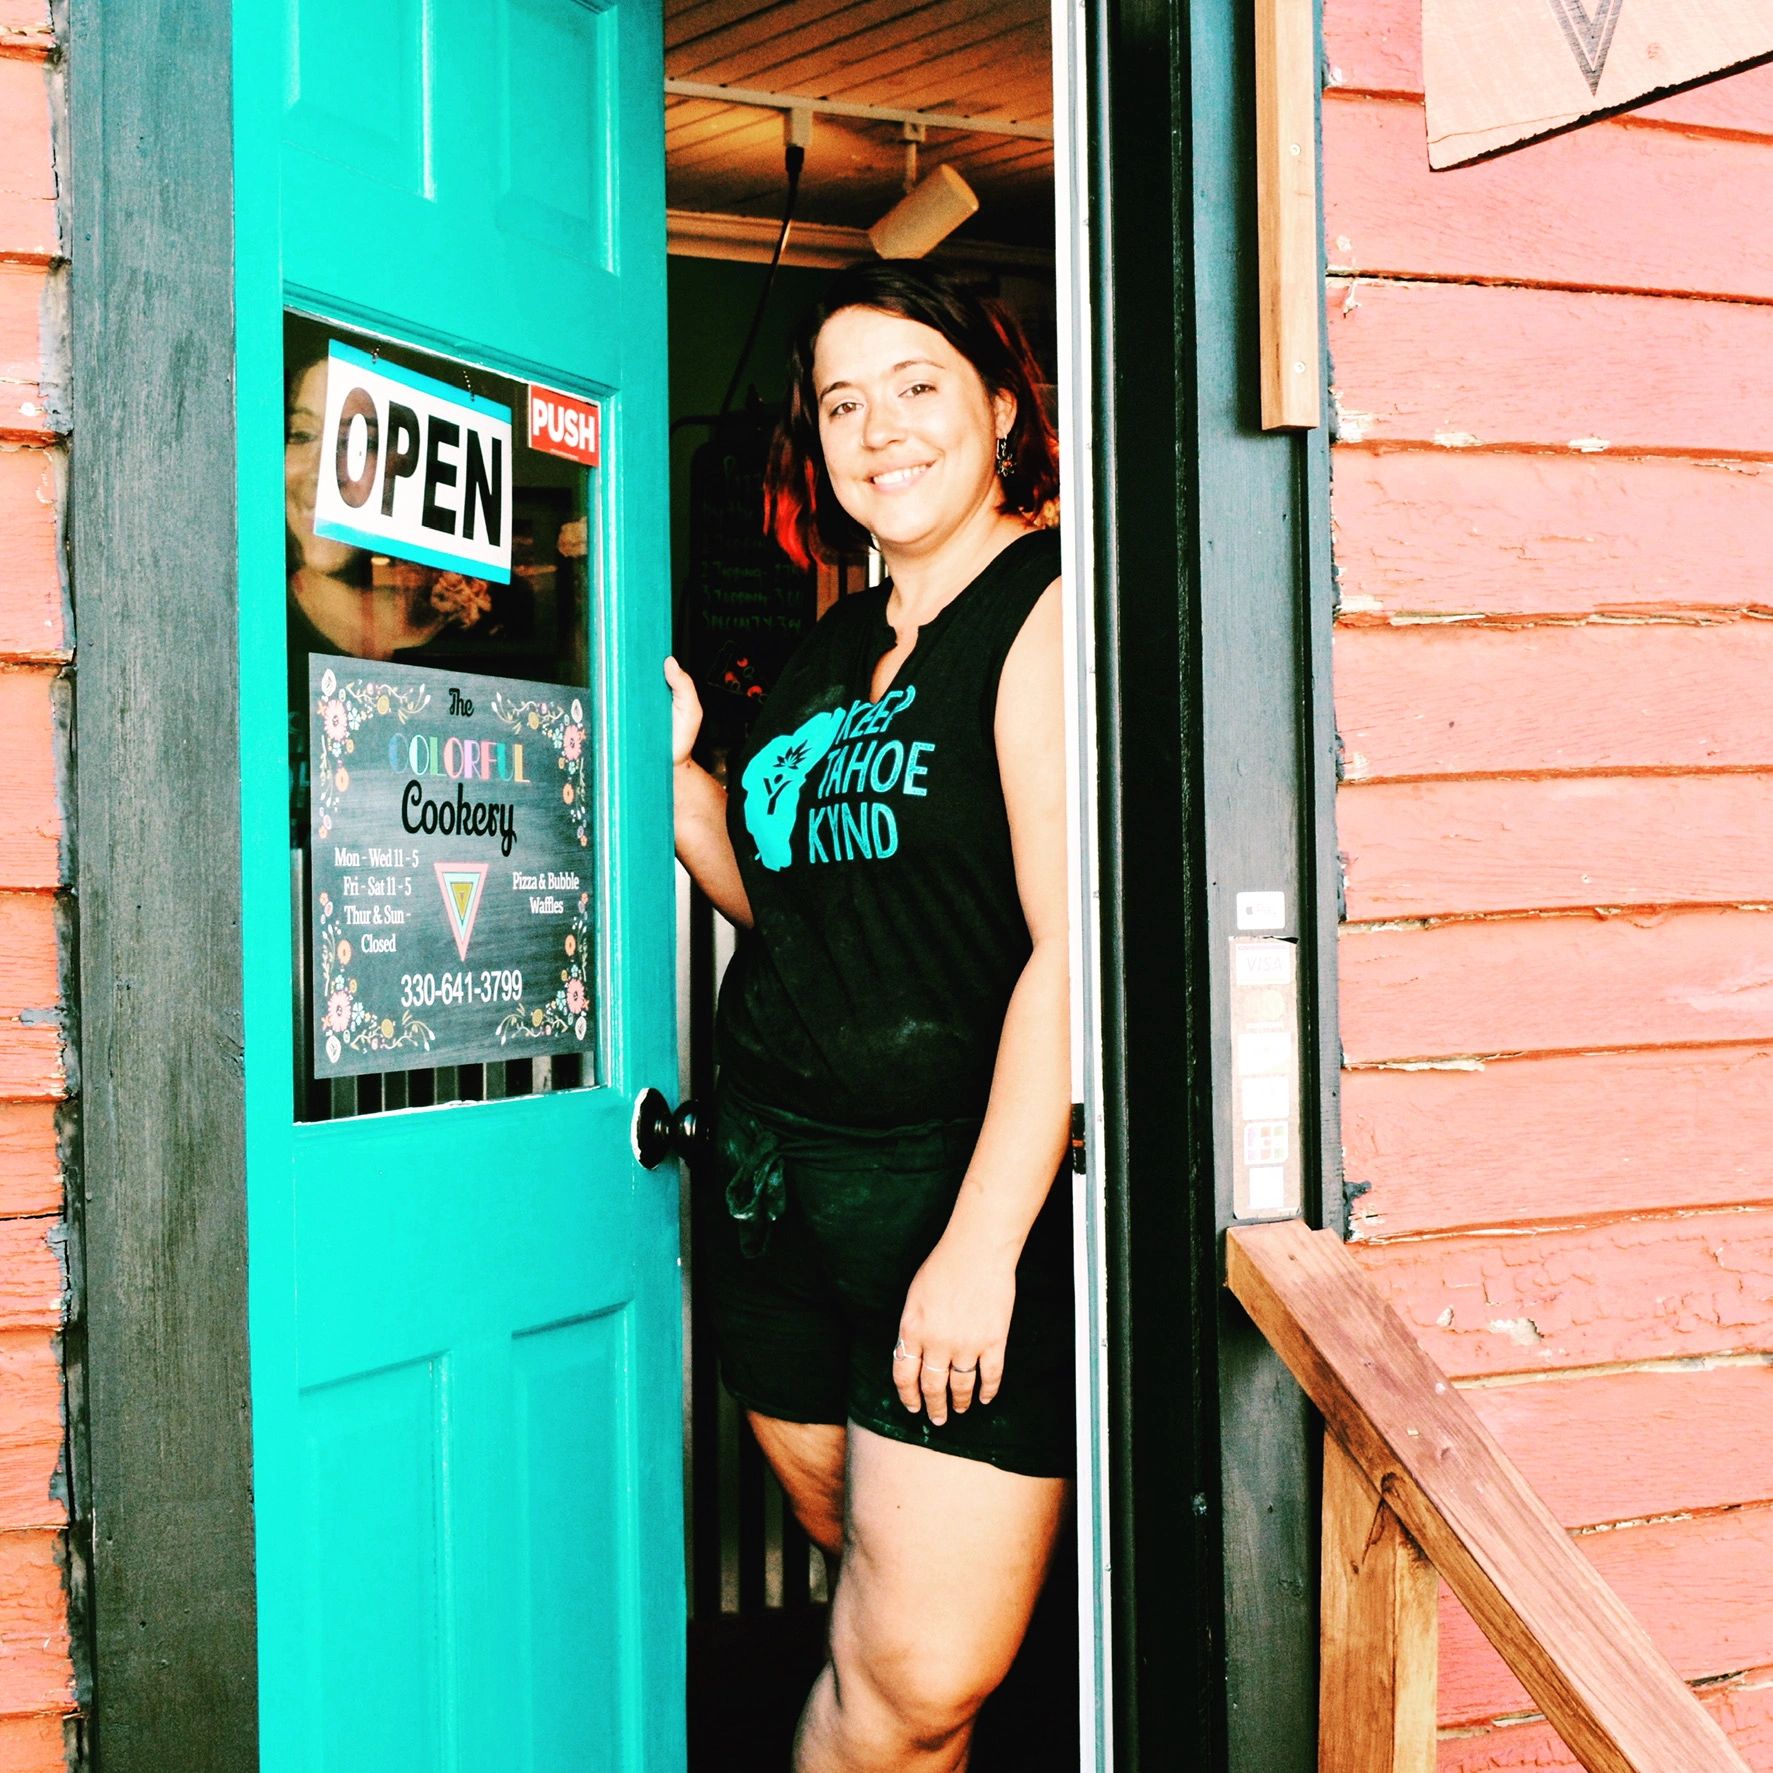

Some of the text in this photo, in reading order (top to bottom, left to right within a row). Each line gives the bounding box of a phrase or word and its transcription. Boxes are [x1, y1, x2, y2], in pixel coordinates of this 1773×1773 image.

[532, 398, 595, 453] PUSH
[336, 387, 502, 548] OPEN
[449, 688, 474, 717] The
[835, 685, 916, 745] KEEP
[388, 733, 531, 783] COLORFUL
[818, 740, 935, 799] TAHOE
[402, 779, 517, 857] Cookery
[809, 802, 898, 863] KYND
[334, 847, 360, 867] Mon
[368, 848, 392, 868] Wed
[394, 848, 404, 868] 11
[412, 849, 419, 868] 5
[343, 876, 359, 896] Fri
[367, 876, 385, 896] Sat
[386, 876, 396, 896] 11
[404, 877, 412, 896] 5
[512, 871, 580, 891] Pizza & Bubble
[343, 905, 372, 925] Thur
[373, 905, 383, 925] &
[384, 904, 405, 925] Sun
[529, 896, 564, 914] Waffles
[361, 933, 397, 954] Closed
[1247, 956, 1283, 972] VISA
[401, 970, 522, 1007] 330-641-3799
